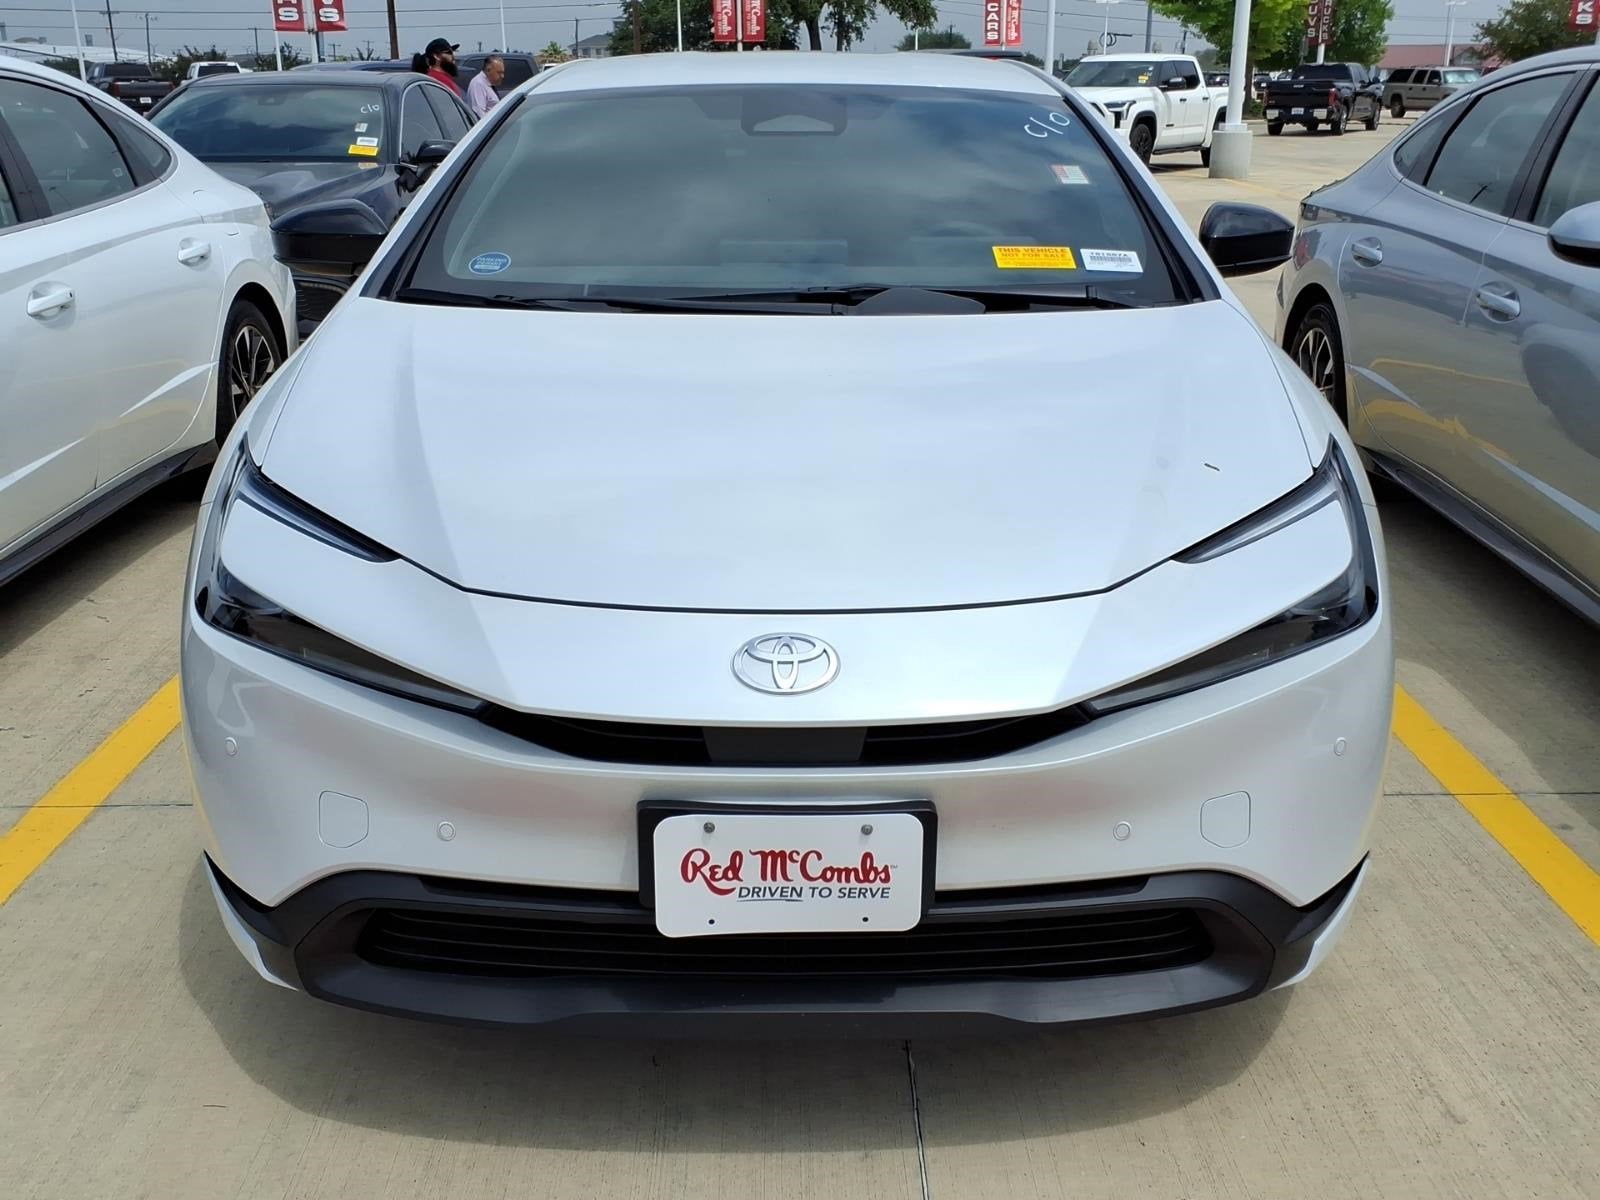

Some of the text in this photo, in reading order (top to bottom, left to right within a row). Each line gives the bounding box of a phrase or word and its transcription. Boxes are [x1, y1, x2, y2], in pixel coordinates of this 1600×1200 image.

[987, 3, 999, 40] CARS
[681, 848, 891, 896] Red McCombs
[738, 886, 892, 899] DRIVEN TO SERVE
